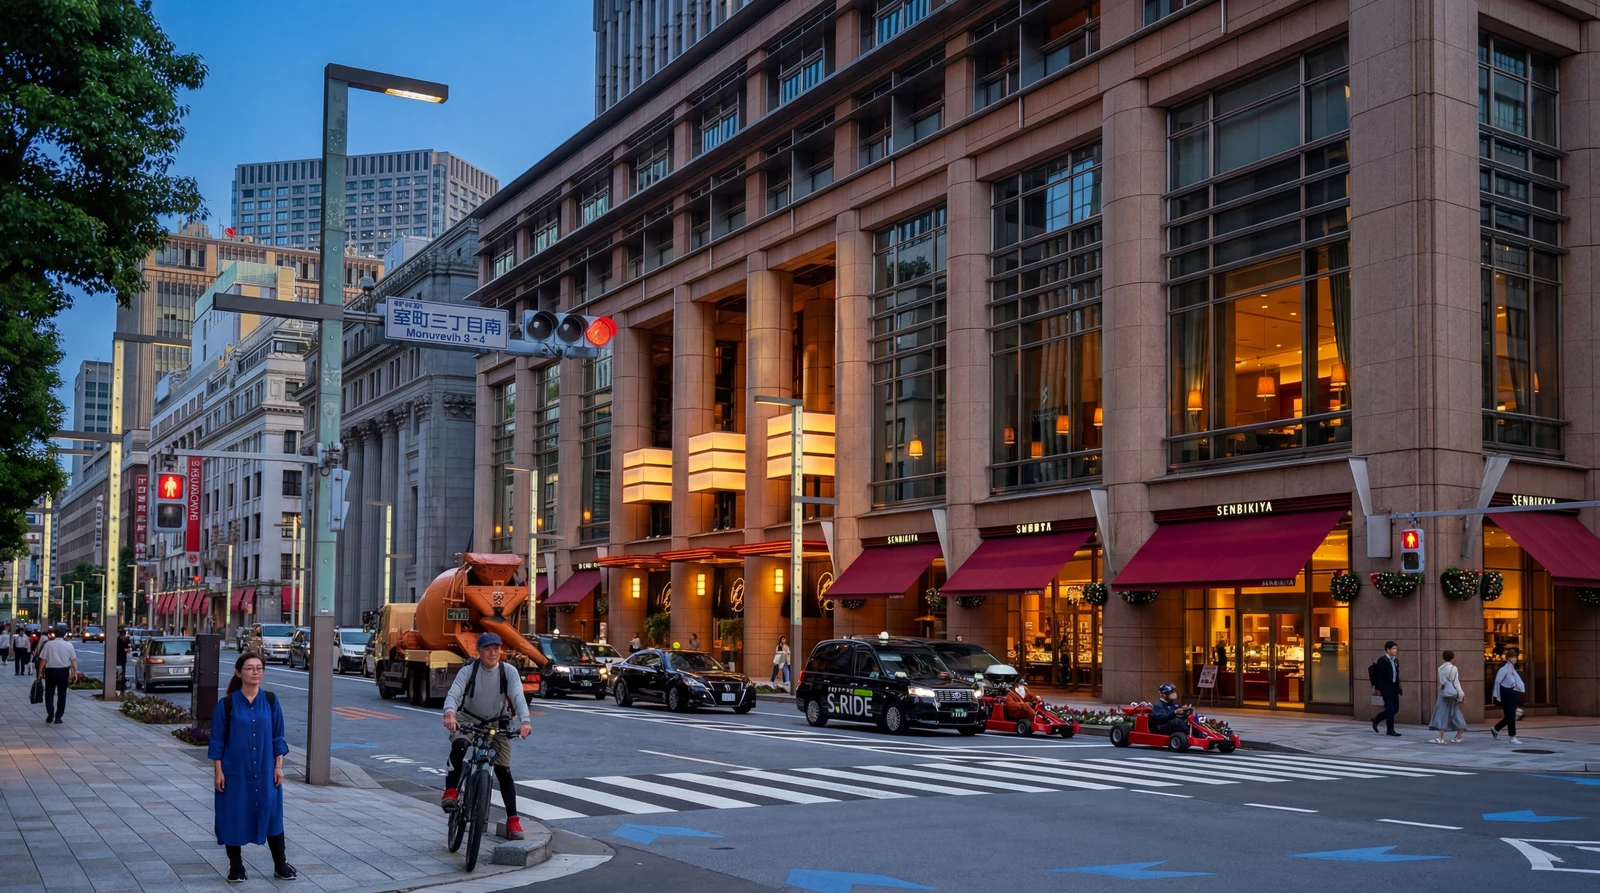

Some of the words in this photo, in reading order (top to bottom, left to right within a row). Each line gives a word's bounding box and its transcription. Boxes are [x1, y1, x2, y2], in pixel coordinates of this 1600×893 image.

[393, 308, 501, 335] 室町三丁目南
[1216, 501, 1273, 516] SENBIKIYA
